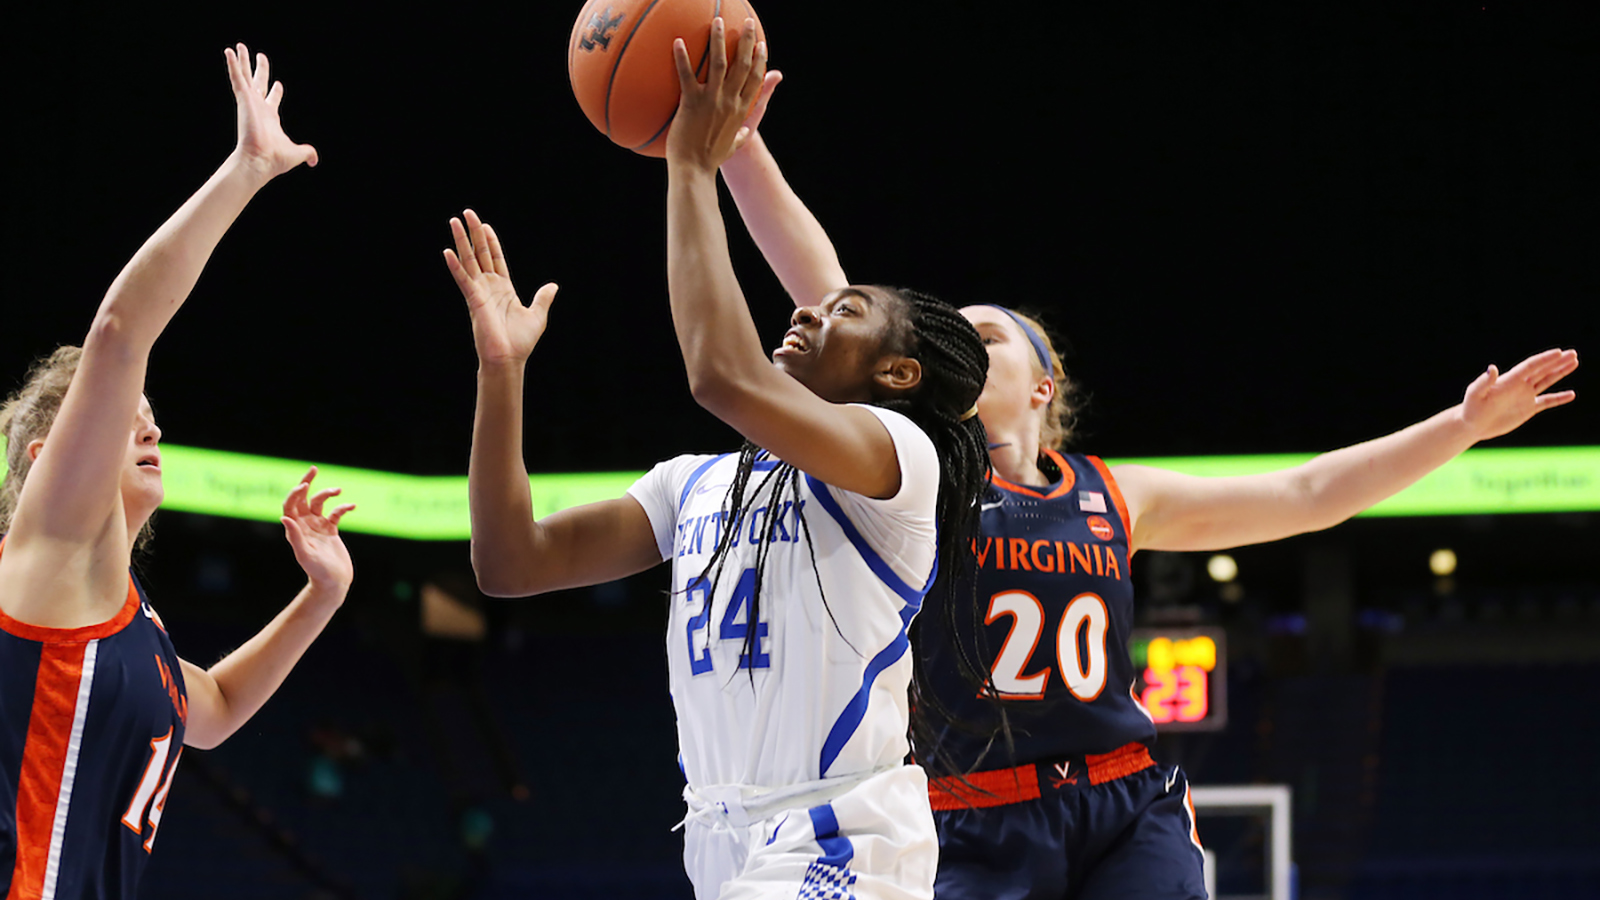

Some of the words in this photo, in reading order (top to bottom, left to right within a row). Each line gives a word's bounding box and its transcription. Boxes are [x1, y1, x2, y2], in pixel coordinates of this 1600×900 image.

[678, 499, 806, 557] ENTUCKY
[968, 537, 1121, 580] VIRGINIA
[686, 567, 771, 677] 24
[977, 589, 1109, 702] 20
[1141, 665, 1208, 723] 23
